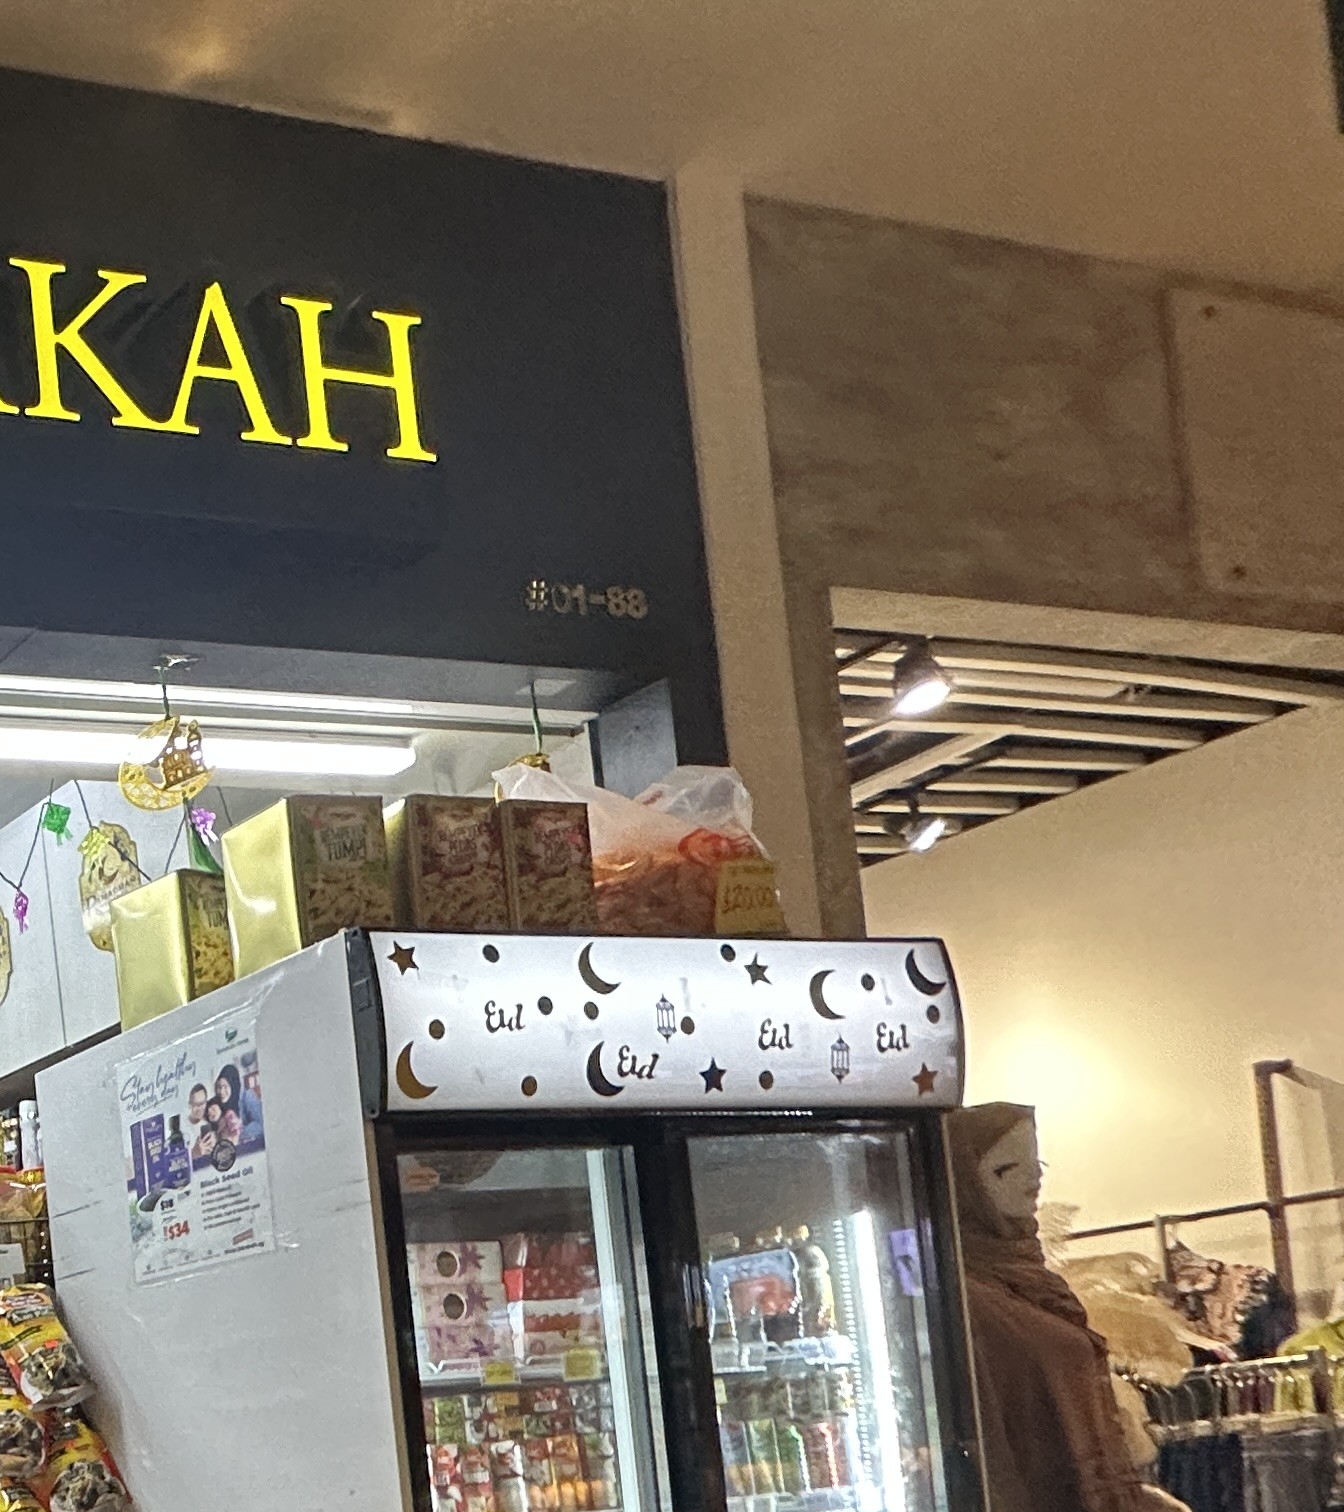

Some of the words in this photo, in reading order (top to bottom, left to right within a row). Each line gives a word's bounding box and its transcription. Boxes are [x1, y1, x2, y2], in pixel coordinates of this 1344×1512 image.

[525, 580, 648, 619] #01-88
[484, 1000, 525, 1033] Eid
[757, 1018, 792, 1050] Eid
[875, 1022, 910, 1053] Eid
[616, 1045, 659, 1079] Eid
